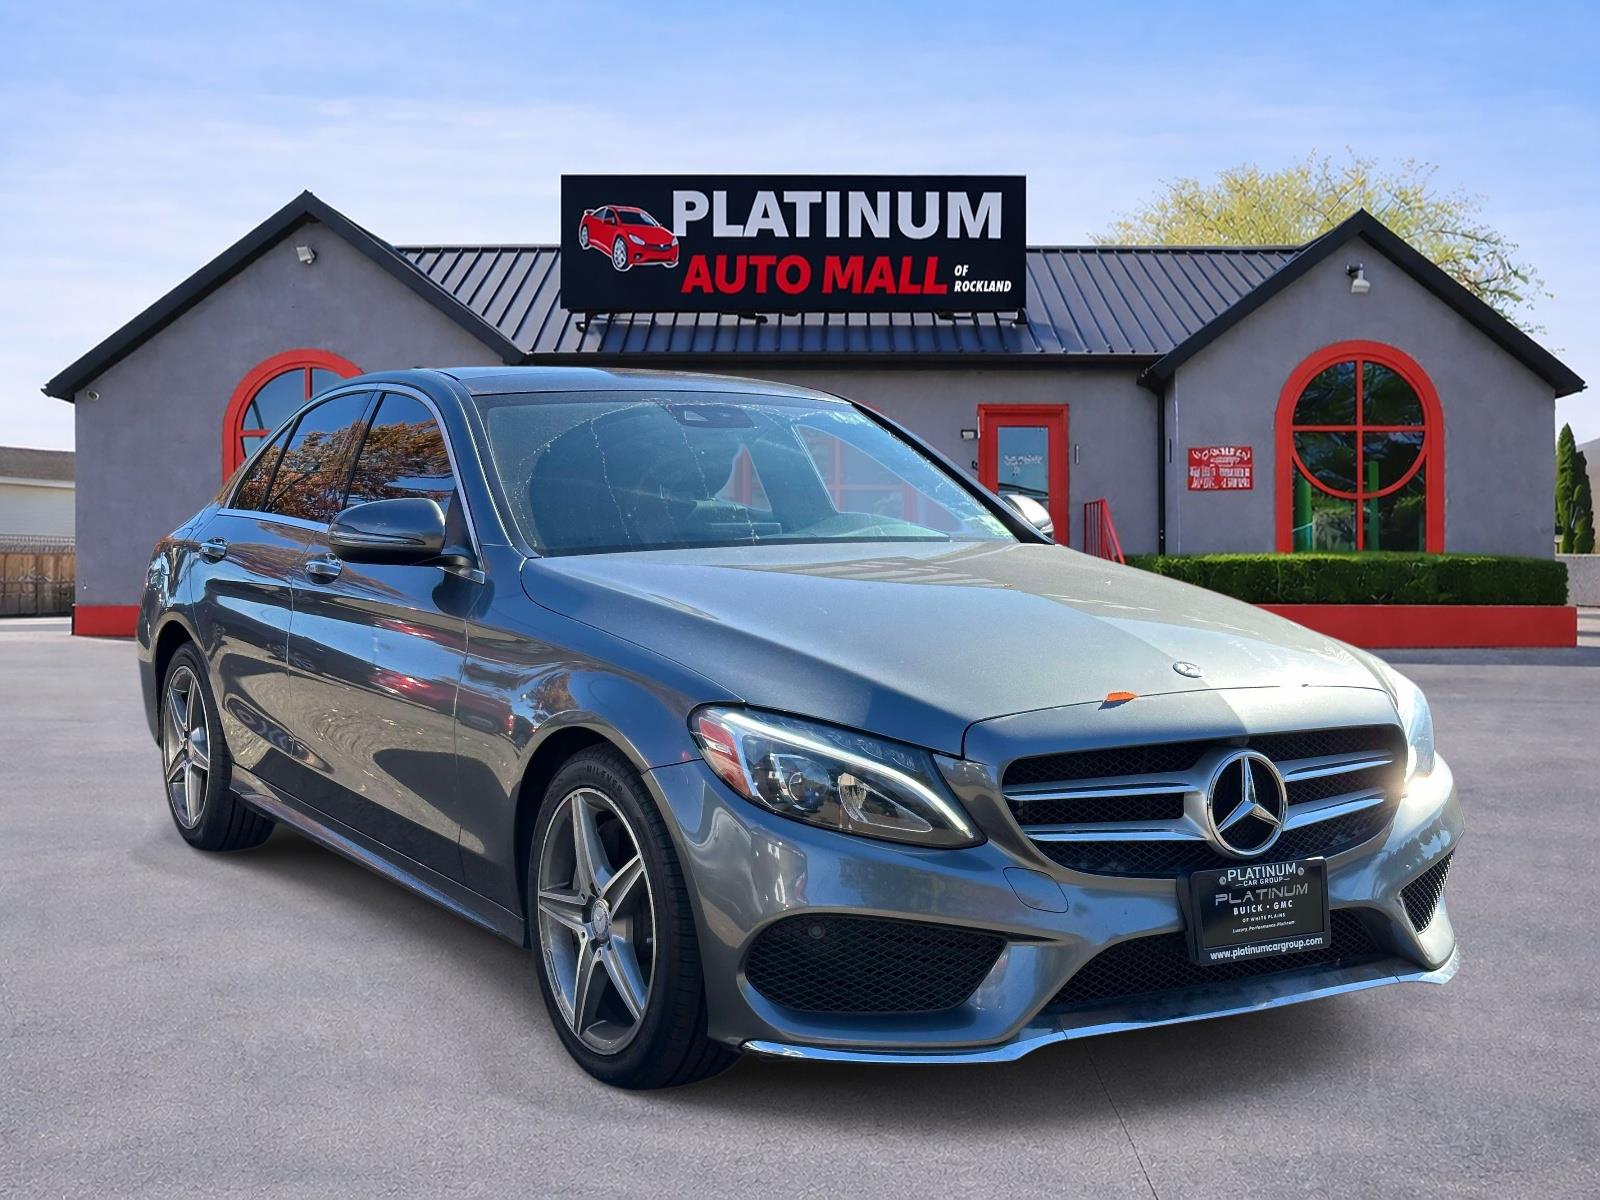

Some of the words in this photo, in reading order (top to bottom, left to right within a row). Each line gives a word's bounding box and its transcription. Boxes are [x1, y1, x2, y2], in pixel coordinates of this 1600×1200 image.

[672, 190, 1002, 239] PLATINUM
[681, 254, 812, 294] AUTO
[822, 255, 948, 295] MALL
[954, 264, 969, 277] OF
[954, 280, 1012, 293] ROCKLAND
[1227, 862, 1296, 882] PLATINUM
[1243, 879, 1258, 887] CAR
[1259, 876, 1284, 885] GROUP
[1215, 883, 1308, 906] PLATINUM
[1233, 903, 1263, 915] BUICK
[1273, 900, 1293, 910] GMC
[1210, 936, 1323, 960] www.platinumcargroup.com
